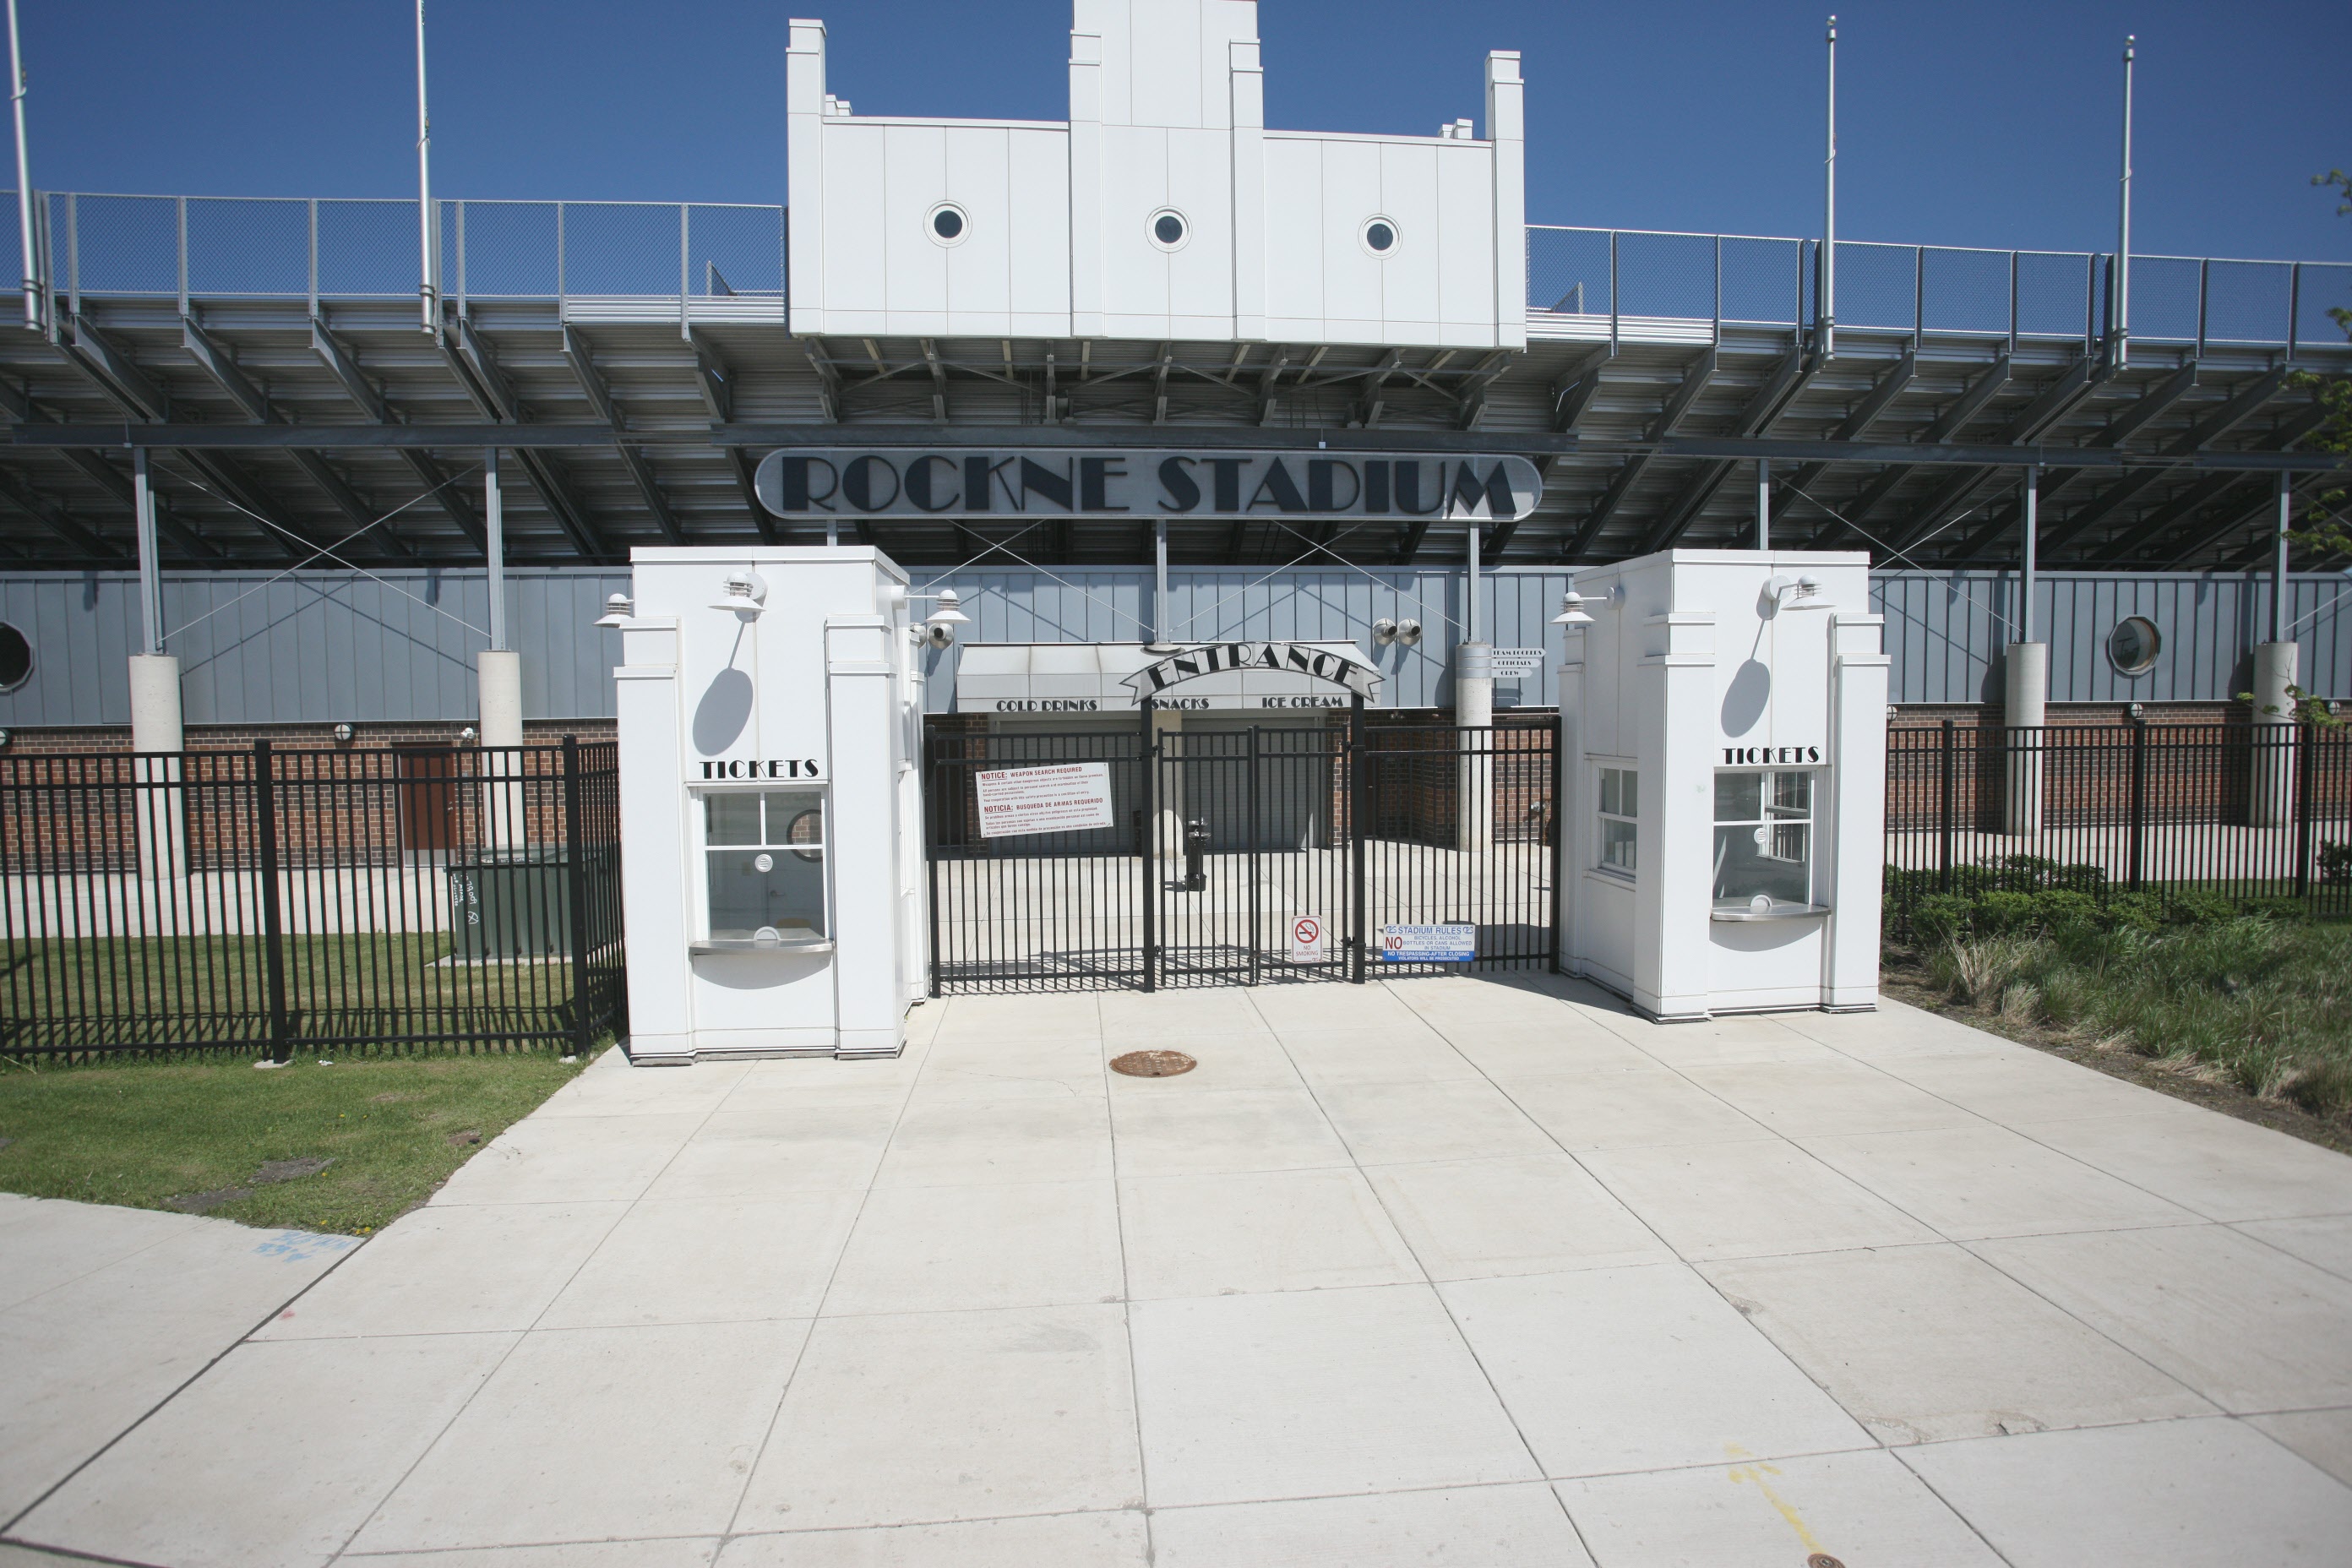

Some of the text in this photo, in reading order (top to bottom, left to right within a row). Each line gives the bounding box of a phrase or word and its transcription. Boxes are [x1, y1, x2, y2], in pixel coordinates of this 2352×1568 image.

[781, 456, 1517, 514] ROCKNE STADIUM
[1147, 643, 1360, 688] ENTRANCE
[996, 696, 1344, 712] COLD DRINKS SNACKS ICE CREAM
[1722, 746, 1819, 764] TICKETS
[699, 759, 818, 779] TICKETS
[1385, 936, 1402, 949] NO
